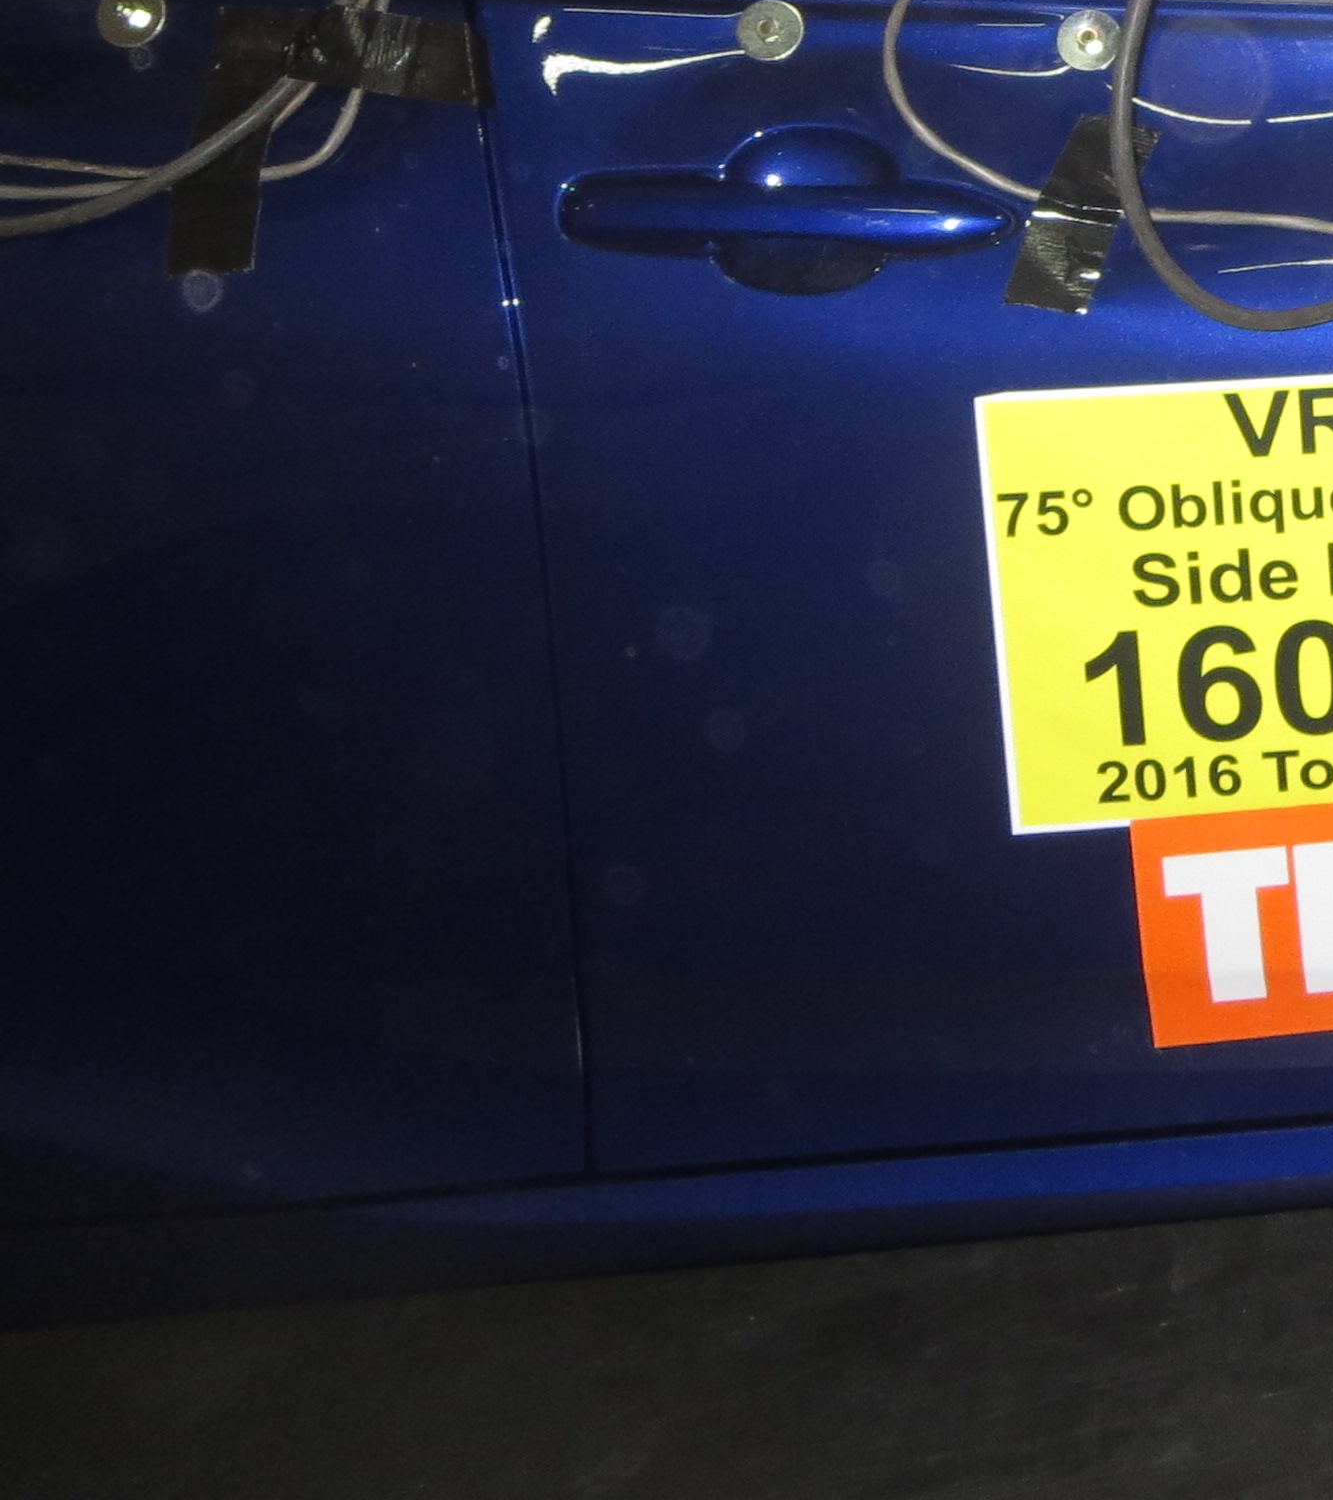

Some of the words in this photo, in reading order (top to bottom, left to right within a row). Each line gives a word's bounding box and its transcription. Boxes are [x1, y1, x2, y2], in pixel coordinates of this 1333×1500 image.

[996, 488, 1094, 538] 75°
[1132, 547, 1299, 608] Side
[1096, 753, 1243, 804] 2016
